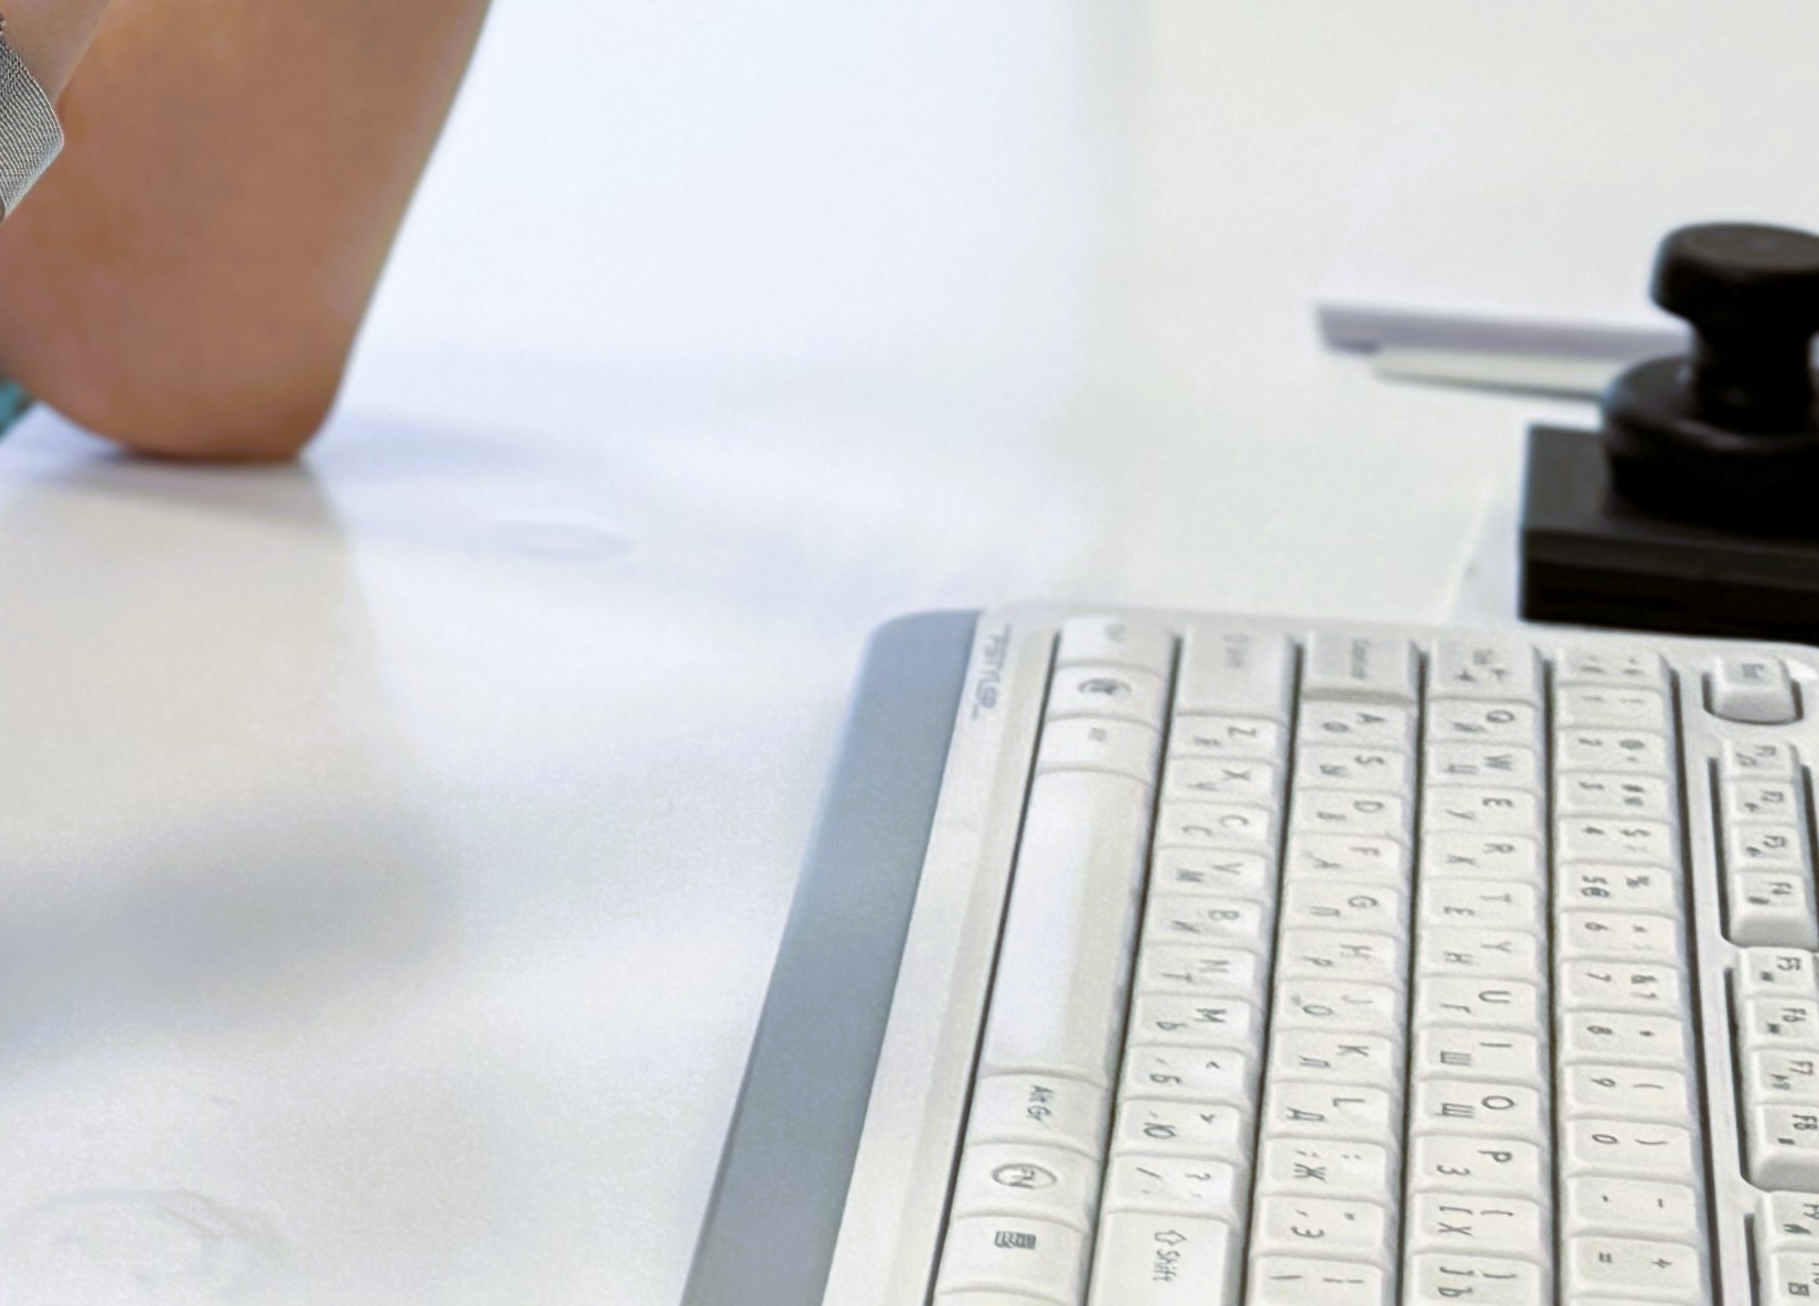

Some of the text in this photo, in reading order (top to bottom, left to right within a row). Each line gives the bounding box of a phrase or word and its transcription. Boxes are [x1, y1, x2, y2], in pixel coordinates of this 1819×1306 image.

[1357, 711, 1387, 725] A
[1486, 709, 1515, 723] Q
[1227, 725, 1257, 739] Z
[1354, 754, 1385, 767] S
[1484, 754, 1514, 772] W
[1441, 763, 1477, 775] Ц
[1483, 797, 1515, 808] E
[1761, 790, 1784, 804] F2
[1353, 800, 1384, 814] D
[1445, 809, 1476, 821] У
[1483, 842, 1515, 854] R
[1763, 835, 1786, 849] F3
[1349, 846, 1381, 857] F
[1211, 862, 1243, 875] V
[1769, 881, 1793, 896] F4
[1347, 896, 1378, 909] G
[1480, 893, 1512, 904] T
[1208, 909, 1240, 921] B
[1310, 905, 1342, 918] П
[1171, 920, 1201, 933] И
[1480, 942, 1512, 952] Y
[1776, 956, 1801, 971] F5
[1478, 990, 1512, 1003] U
[1440, 1003, 1472, 1014] Г
[1782, 1008, 1806, 1022] F6
[1194, 1007, 1228, 1024] M
[1587, 1025, 1614, 1035] 8
[1336, 1044, 1370, 1056] K
[1299, 1056, 1332, 1068] Л
[1440, 1050, 1473, 1067] Ш
[1789, 1060, 1814, 1075] F7
[1149, 1073, 1182, 1085] Б
[1031, 1084, 1053, 1103] Alt
[1331, 1097, 1366, 1107] L
[1481, 1095, 1515, 1110] O
[1027, 1105, 1052, 1123] Gr
[1286, 1107, 1325, 1121] Д
[1435, 1102, 1475, 1119] Щ
[1792, 1114, 1818, 1130] F8
[1143, 1121, 1177, 1139] Ю
[1591, 1133, 1618, 1145] 0
[1478, 1149, 1513, 1163] P
[1293, 1163, 1326, 1181] Ж
[1291, 1226, 1325, 1239] Э
[1152, 1249, 1181, 1283] Shift
[1437, 1286, 1474, 1298] Ъ
